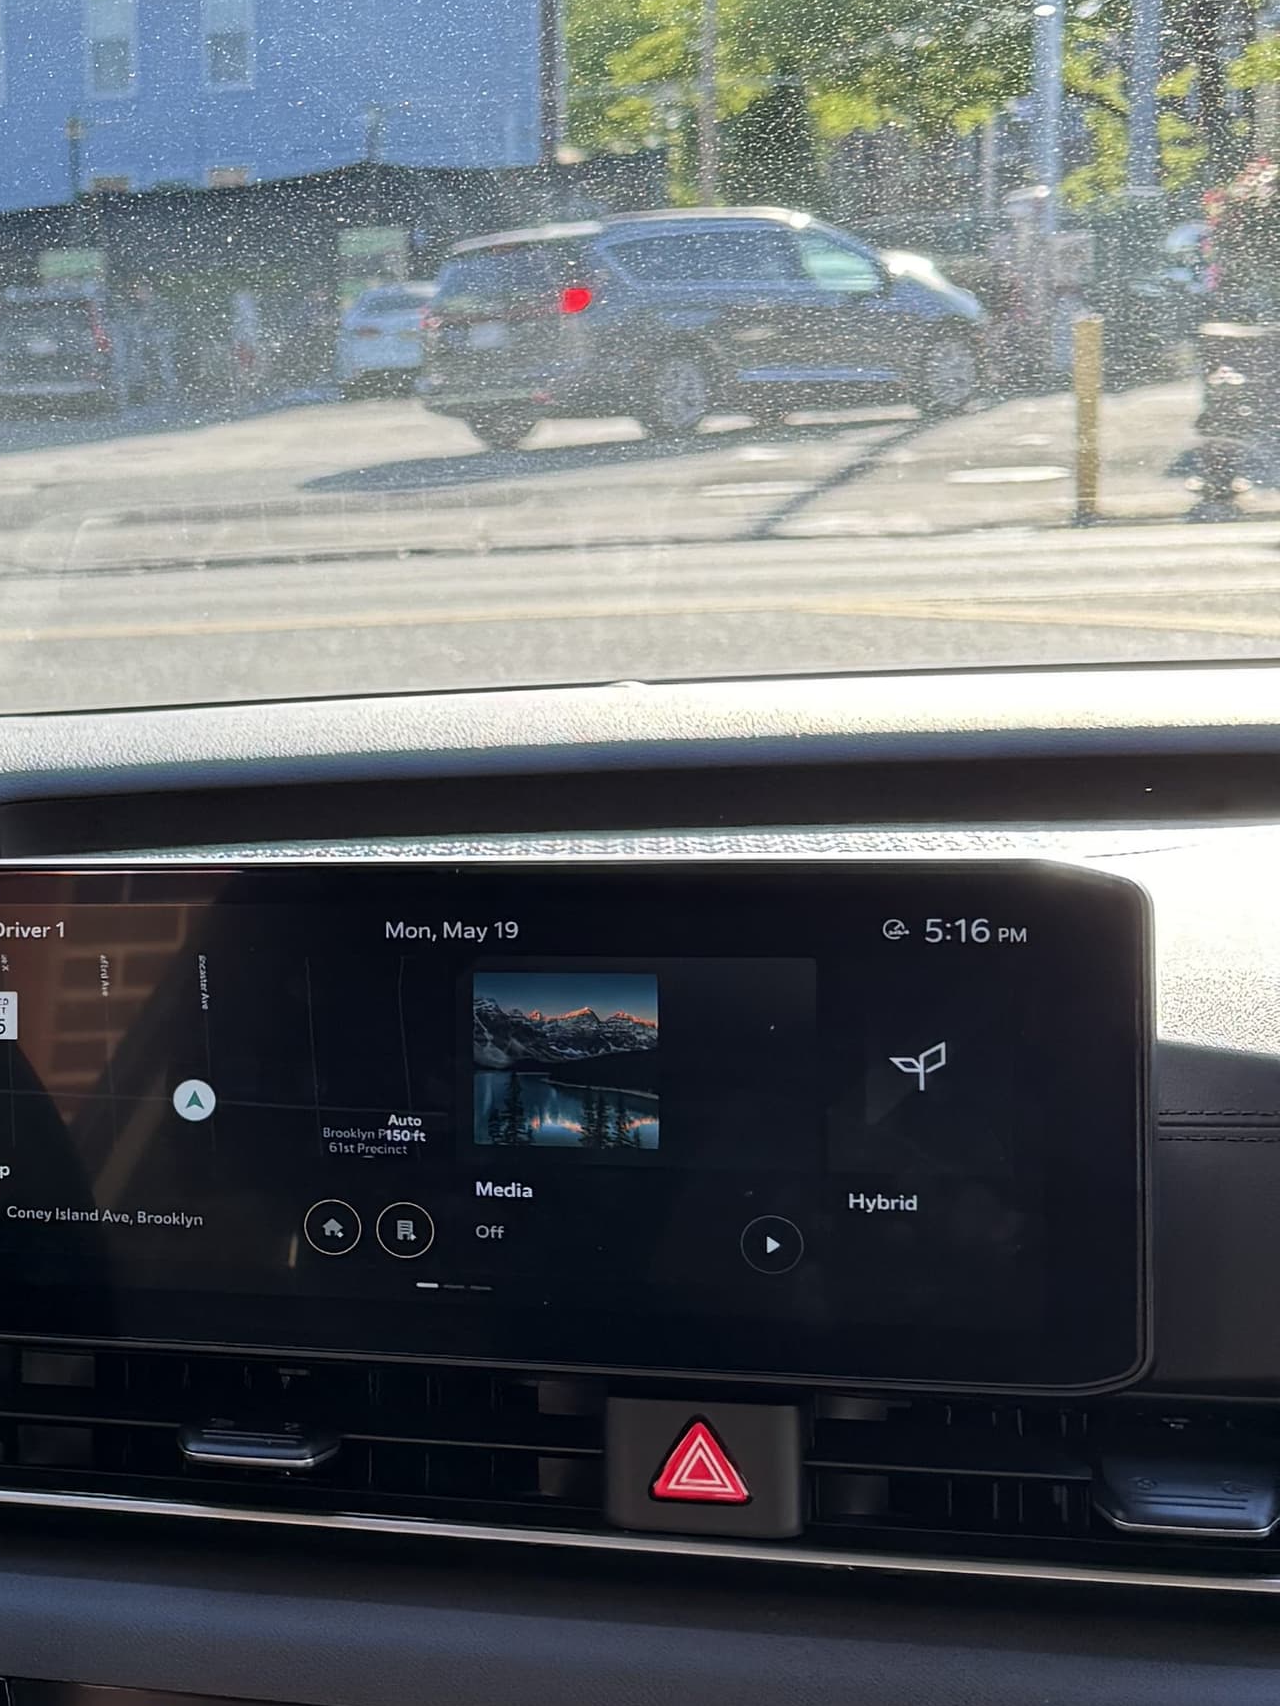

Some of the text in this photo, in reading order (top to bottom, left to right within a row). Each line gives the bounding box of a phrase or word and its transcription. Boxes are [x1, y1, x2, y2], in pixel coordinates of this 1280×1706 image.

[56, 921, 65, 939] 1
[385, 920, 520, 943] Mon, May 19
[924, 918, 1028, 943] 5:16 PM
[387, 1113, 423, 1127] Auto
[322, 1126, 376, 1141] Brooklyn
[385, 1129, 411, 1142] 150
[412, 1129, 427, 1142] ft
[328, 1141, 409, 1155] 61st Precinct
[474, 1180, 534, 1199] Media
[847, 1191, 919, 1214] Hybrid
[6, 1205, 205, 1228] Coney Island Ave, Brooklyn
[474, 1224, 506, 1240] Off
